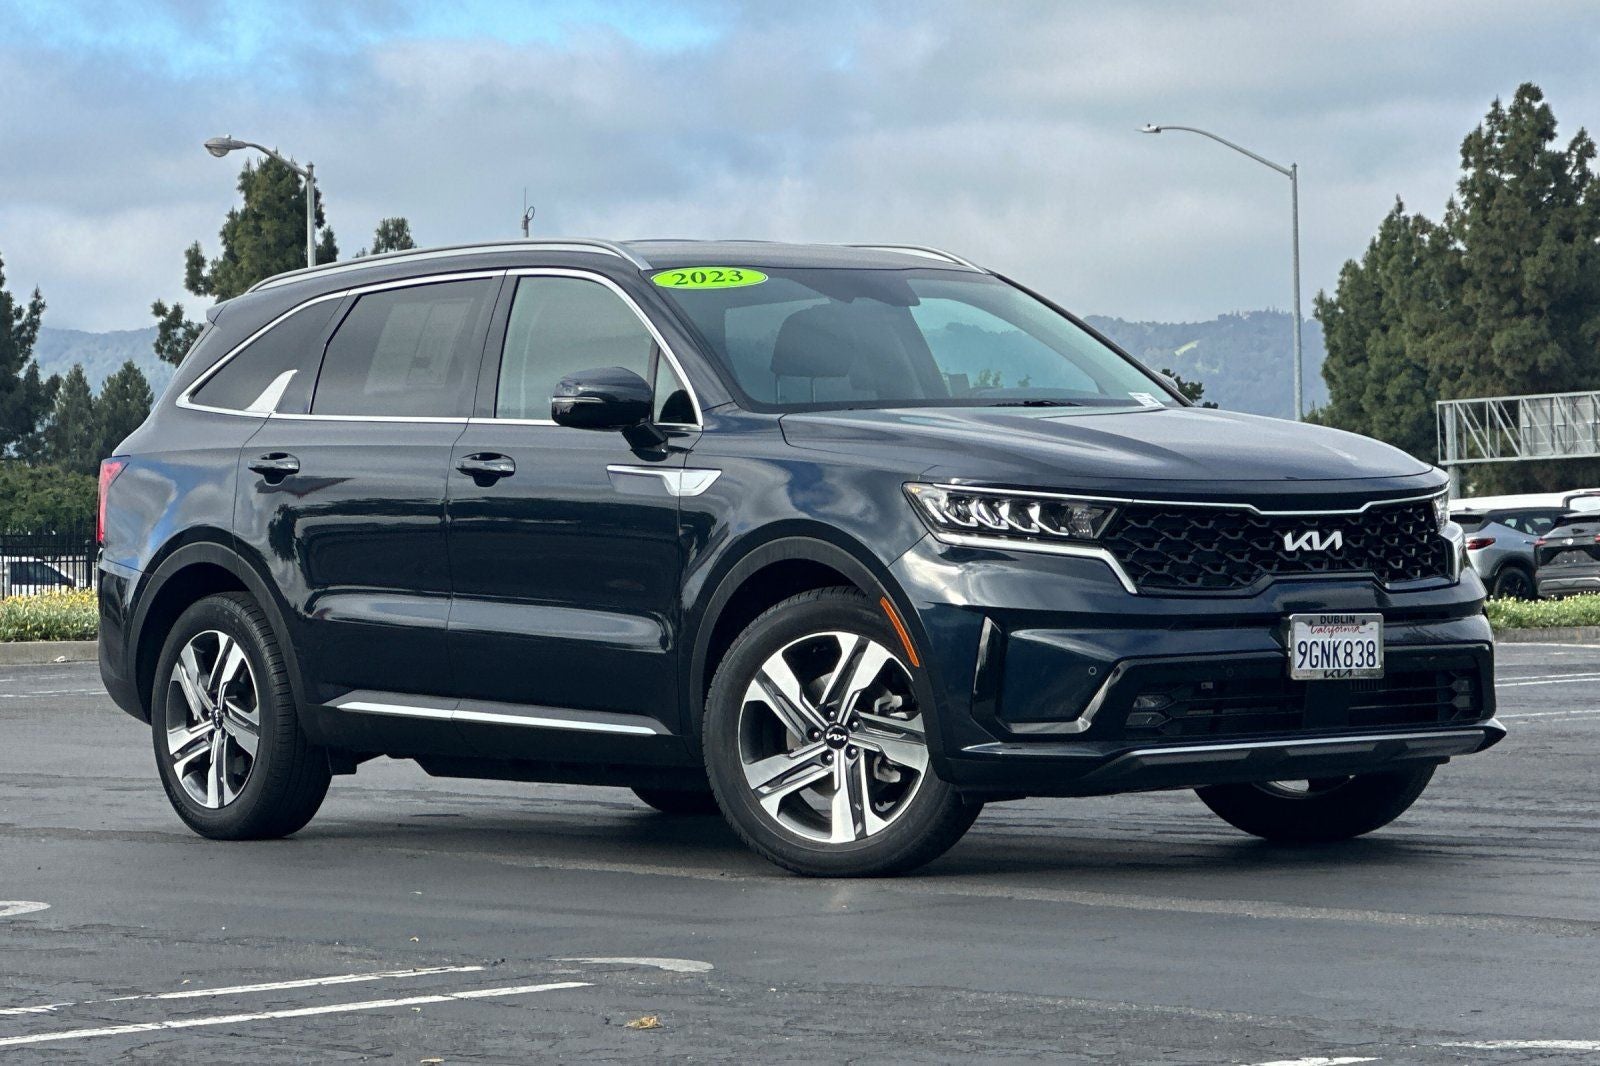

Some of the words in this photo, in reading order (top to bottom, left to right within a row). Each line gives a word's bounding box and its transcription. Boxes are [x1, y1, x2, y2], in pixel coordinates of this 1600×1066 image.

[671, 270, 744, 286] 2023
[1283, 530, 1343, 551] KIA
[1320, 615, 1356, 625] DUBLIN
[1310, 624, 1366, 638] California
[1297, 640, 1376, 669] 9GNK838
[1323, 669, 1353, 679] KIA
